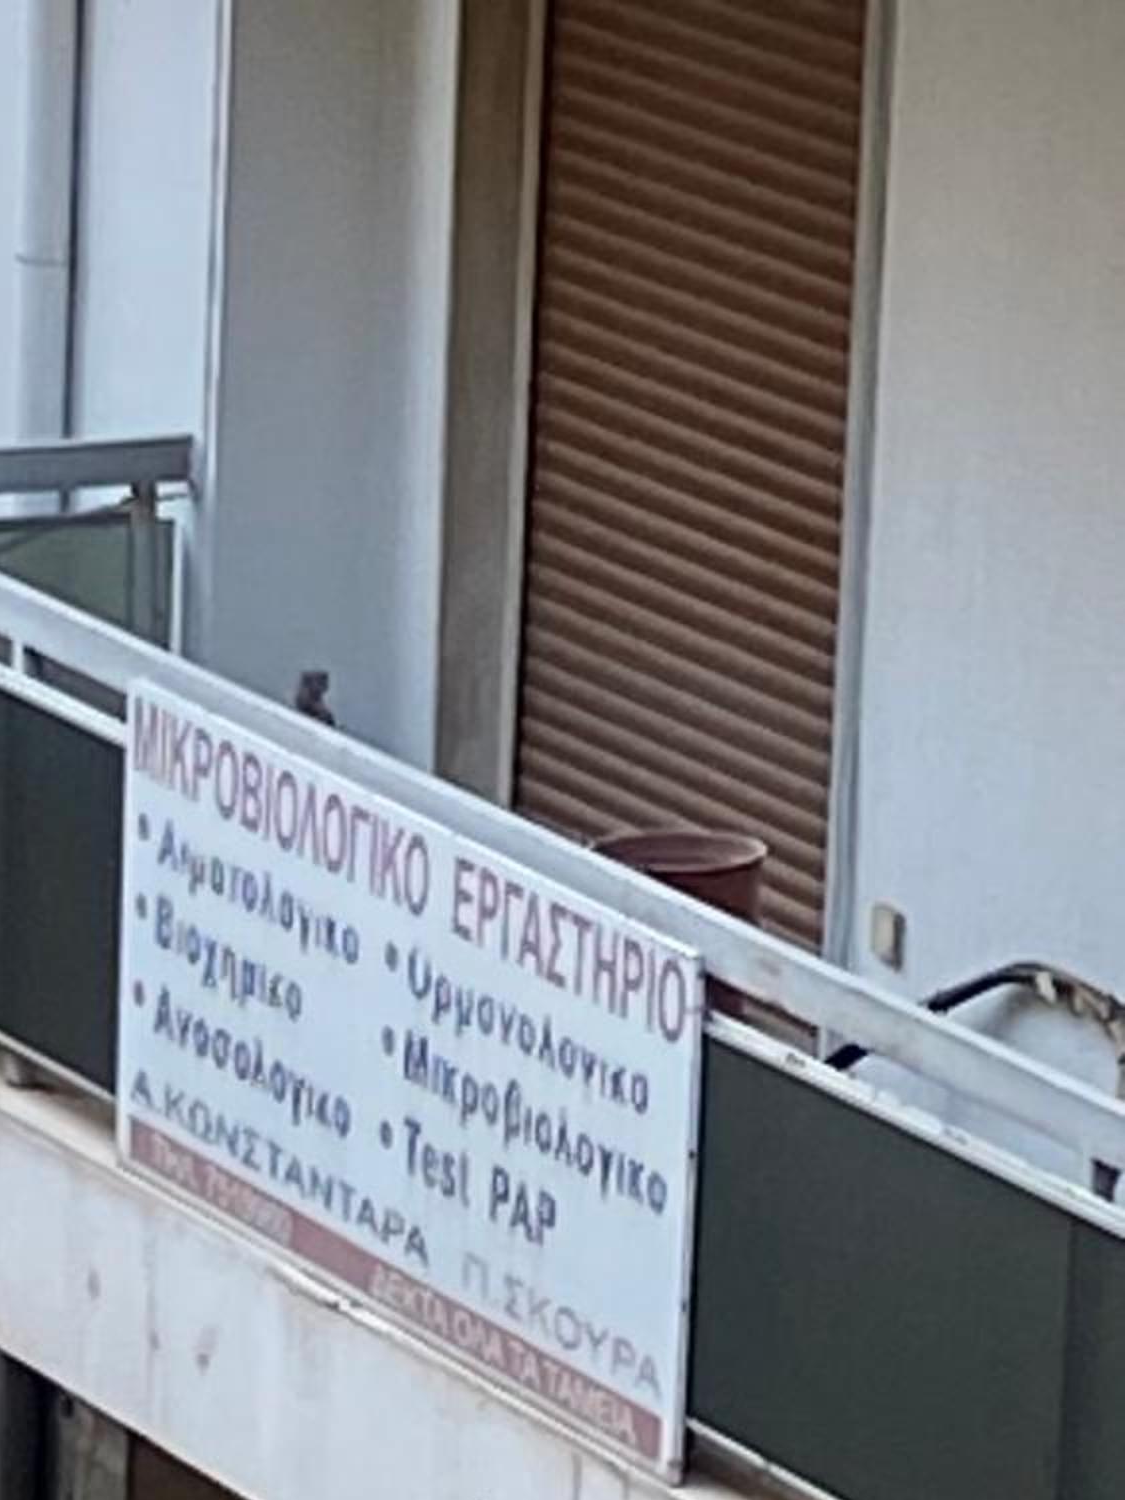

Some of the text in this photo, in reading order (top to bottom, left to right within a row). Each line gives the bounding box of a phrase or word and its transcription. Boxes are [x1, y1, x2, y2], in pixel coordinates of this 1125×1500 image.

[132, 695, 687, 1044] ΜΙΚΡΟΒΙΟΛΟΓΙΚΟ ΕΡΓΑΣΤΗΡΙΟ
[154, 894, 303, 1030] Βιοχημικο
[403, 1028, 669, 1222] Μικροβιολογικο
